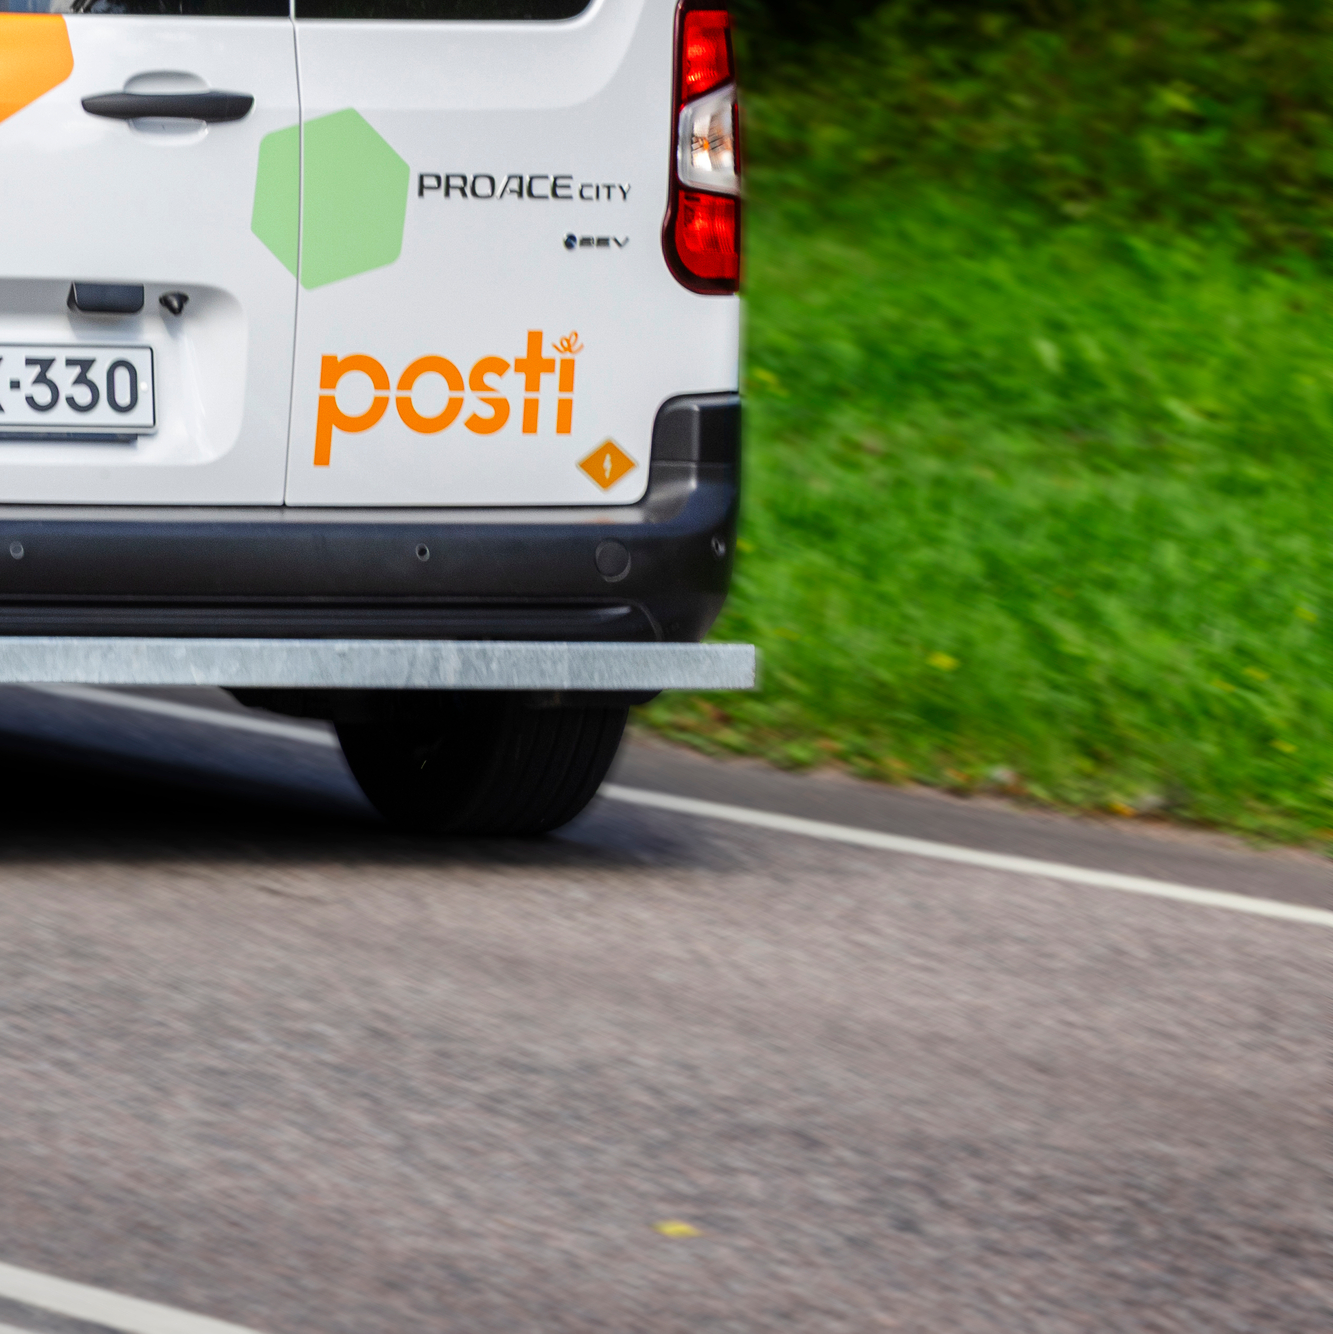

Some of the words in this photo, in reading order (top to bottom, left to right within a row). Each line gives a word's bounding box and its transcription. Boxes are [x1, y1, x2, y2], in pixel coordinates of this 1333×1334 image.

[418, 173, 573, 200] PROACE
[579, 183, 631, 200] CITY
[313, 330, 584, 467] posti
